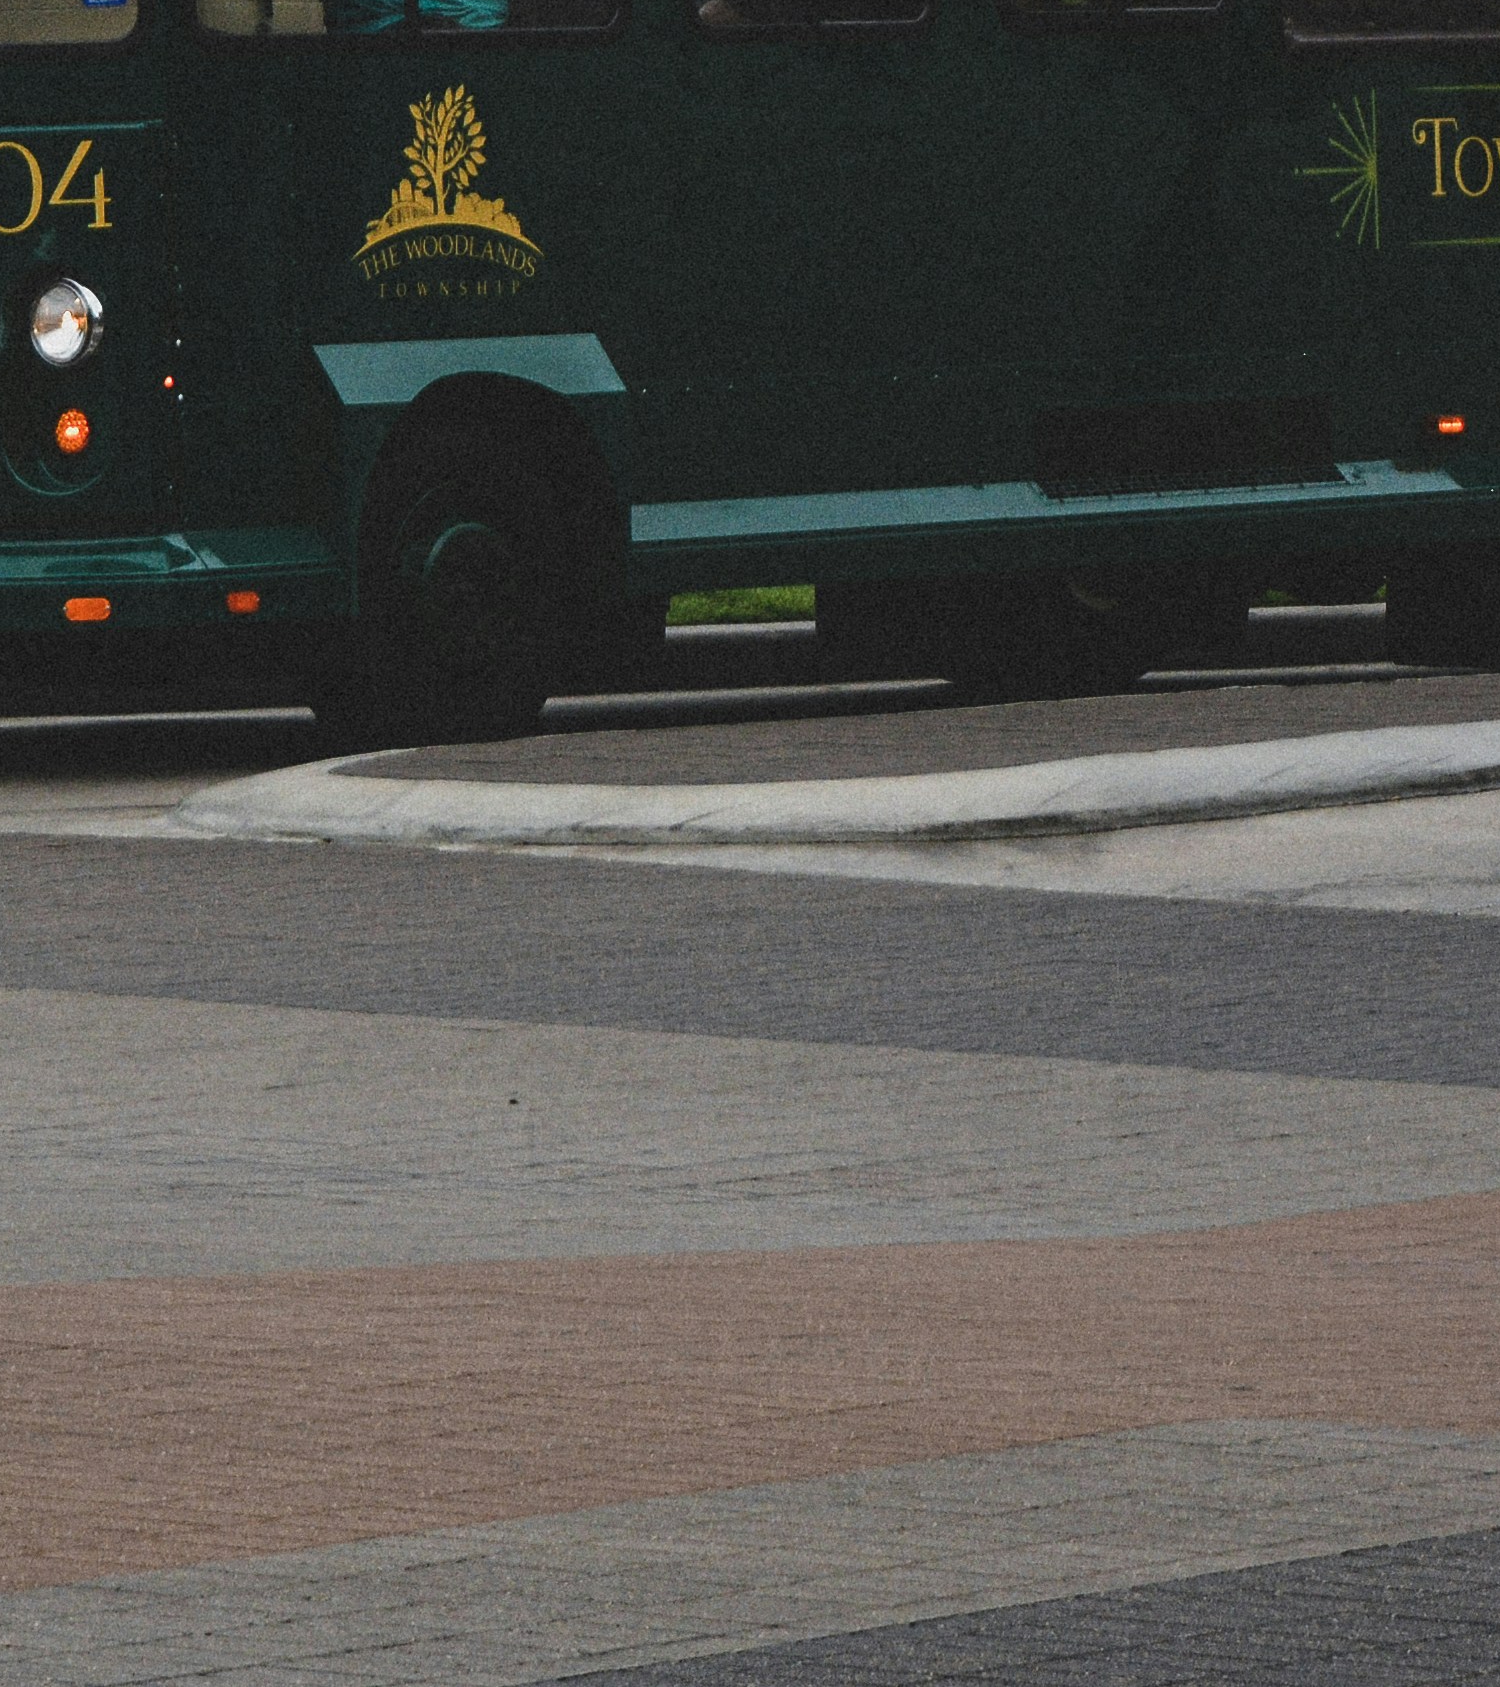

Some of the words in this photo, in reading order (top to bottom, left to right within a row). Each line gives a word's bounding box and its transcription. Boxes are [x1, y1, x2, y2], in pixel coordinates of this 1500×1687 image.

[358, 246, 402, 282] THE
[405, 233, 538, 279] WOODLANDS
[378, 279, 521, 299] TOWNSHIP
